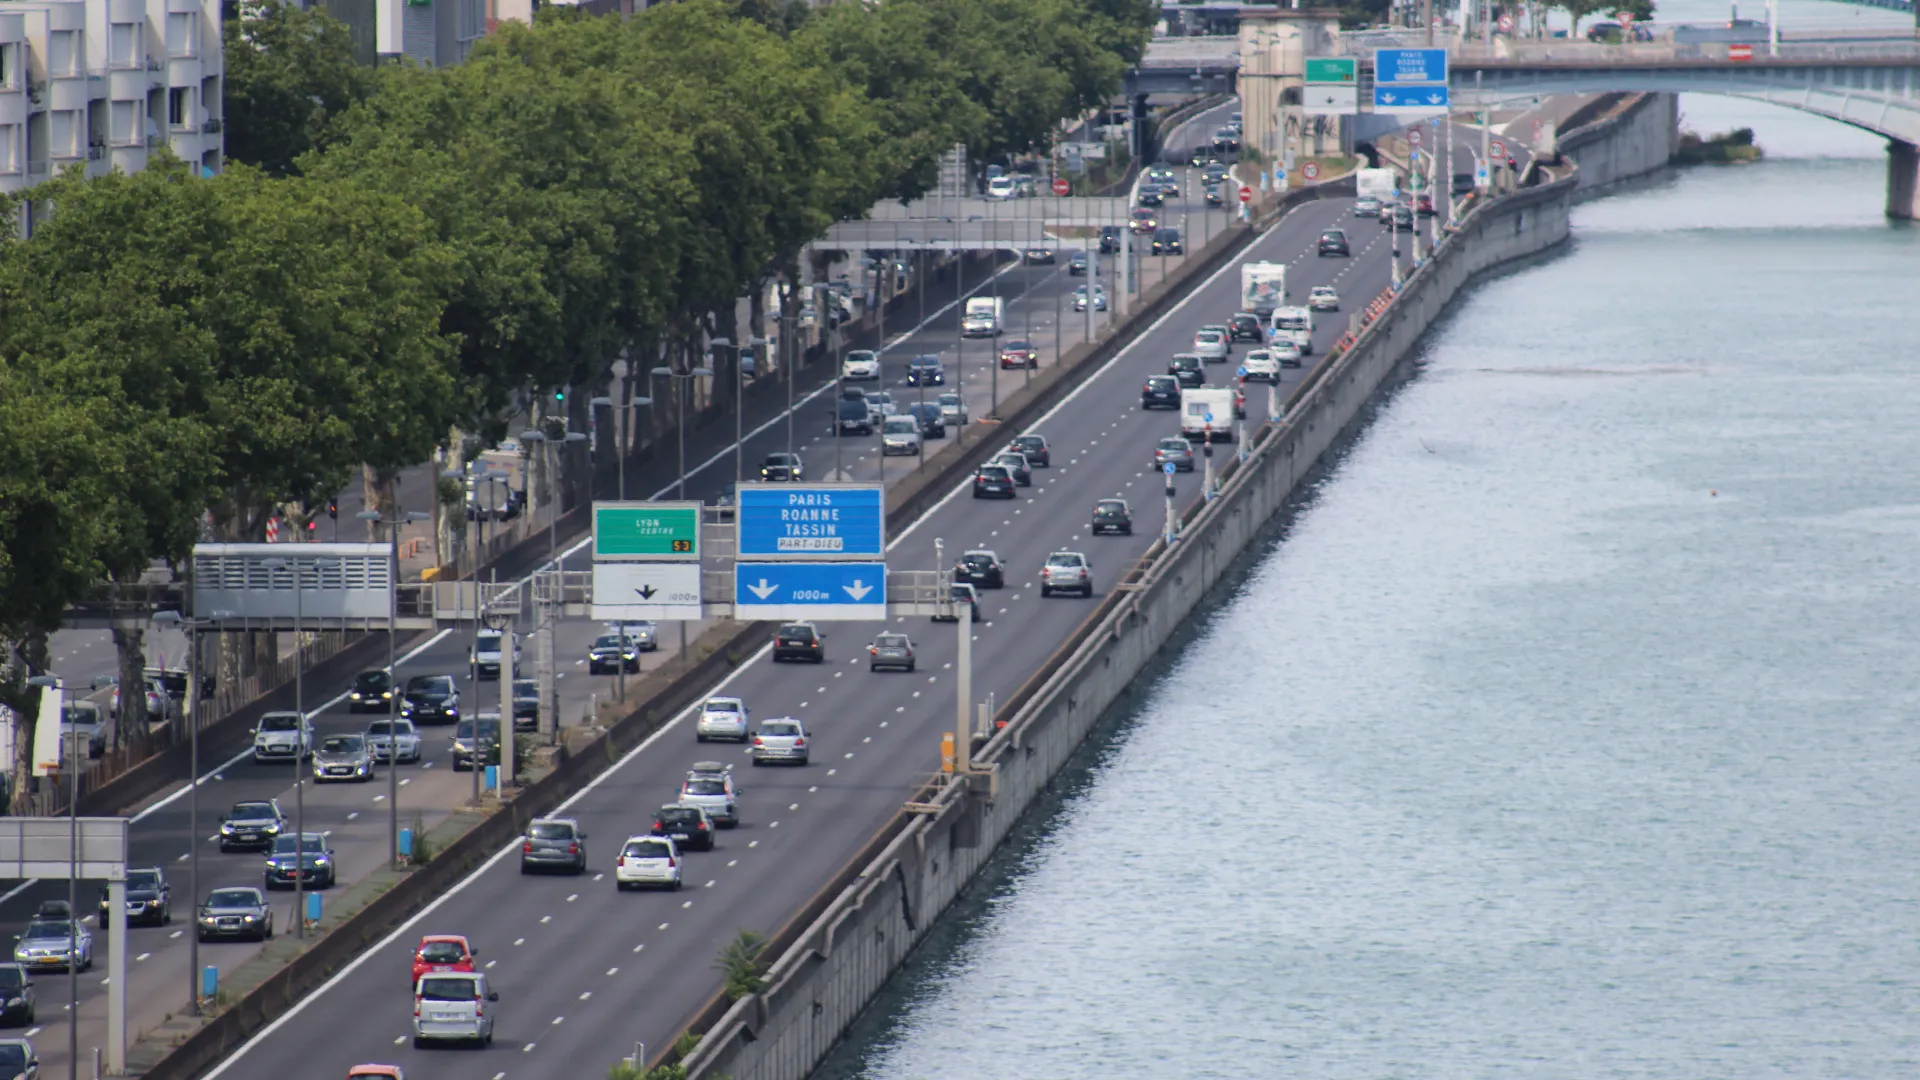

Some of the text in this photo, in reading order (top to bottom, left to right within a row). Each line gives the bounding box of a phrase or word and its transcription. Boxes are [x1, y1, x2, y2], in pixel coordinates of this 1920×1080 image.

[788, 493, 832, 506] PARIS
[781, 508, 840, 521] ROANNE
[635, 518, 660, 527] LYON
[785, 523, 836, 536] TASSIN
[779, 539, 842, 549] PART-DIEU
